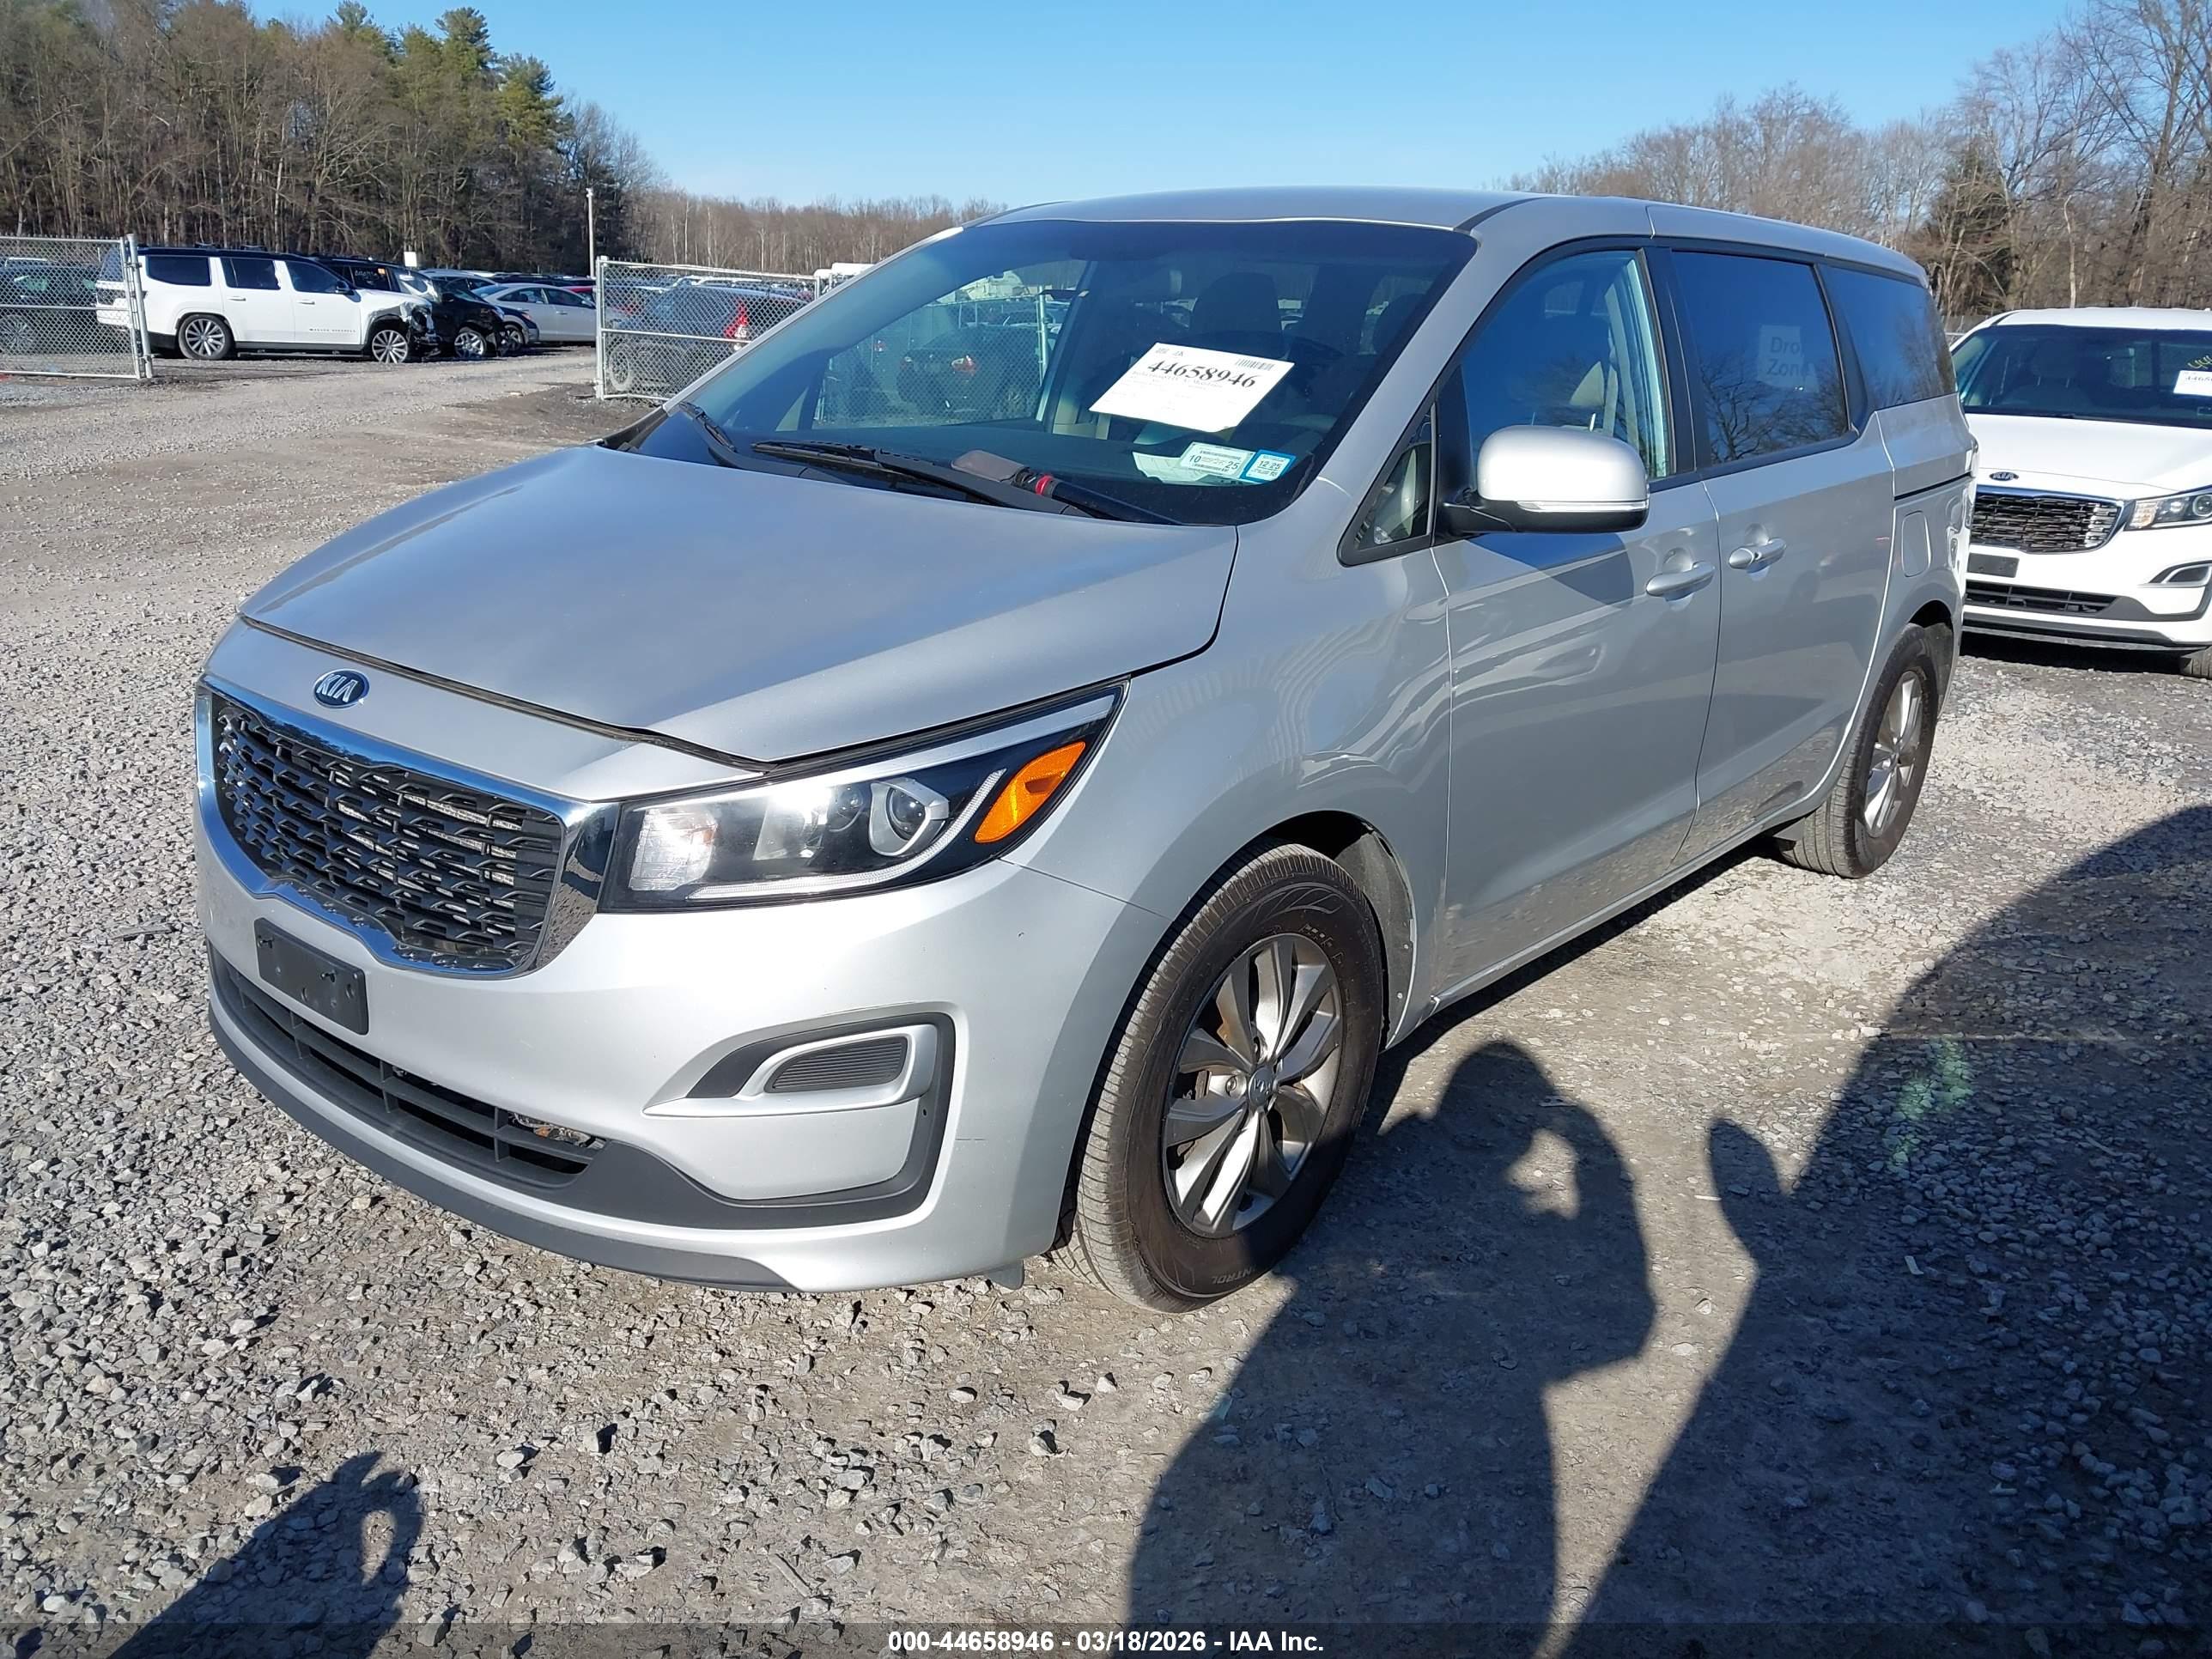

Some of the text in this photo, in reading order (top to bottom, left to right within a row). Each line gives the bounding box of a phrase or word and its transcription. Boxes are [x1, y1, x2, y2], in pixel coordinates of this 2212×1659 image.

[1146, 360, 1262, 389] 44658946
[1188, 454, 1202, 464] 10
[1224, 459, 1238, 471] 25
[316, 673, 359, 702] KIA
